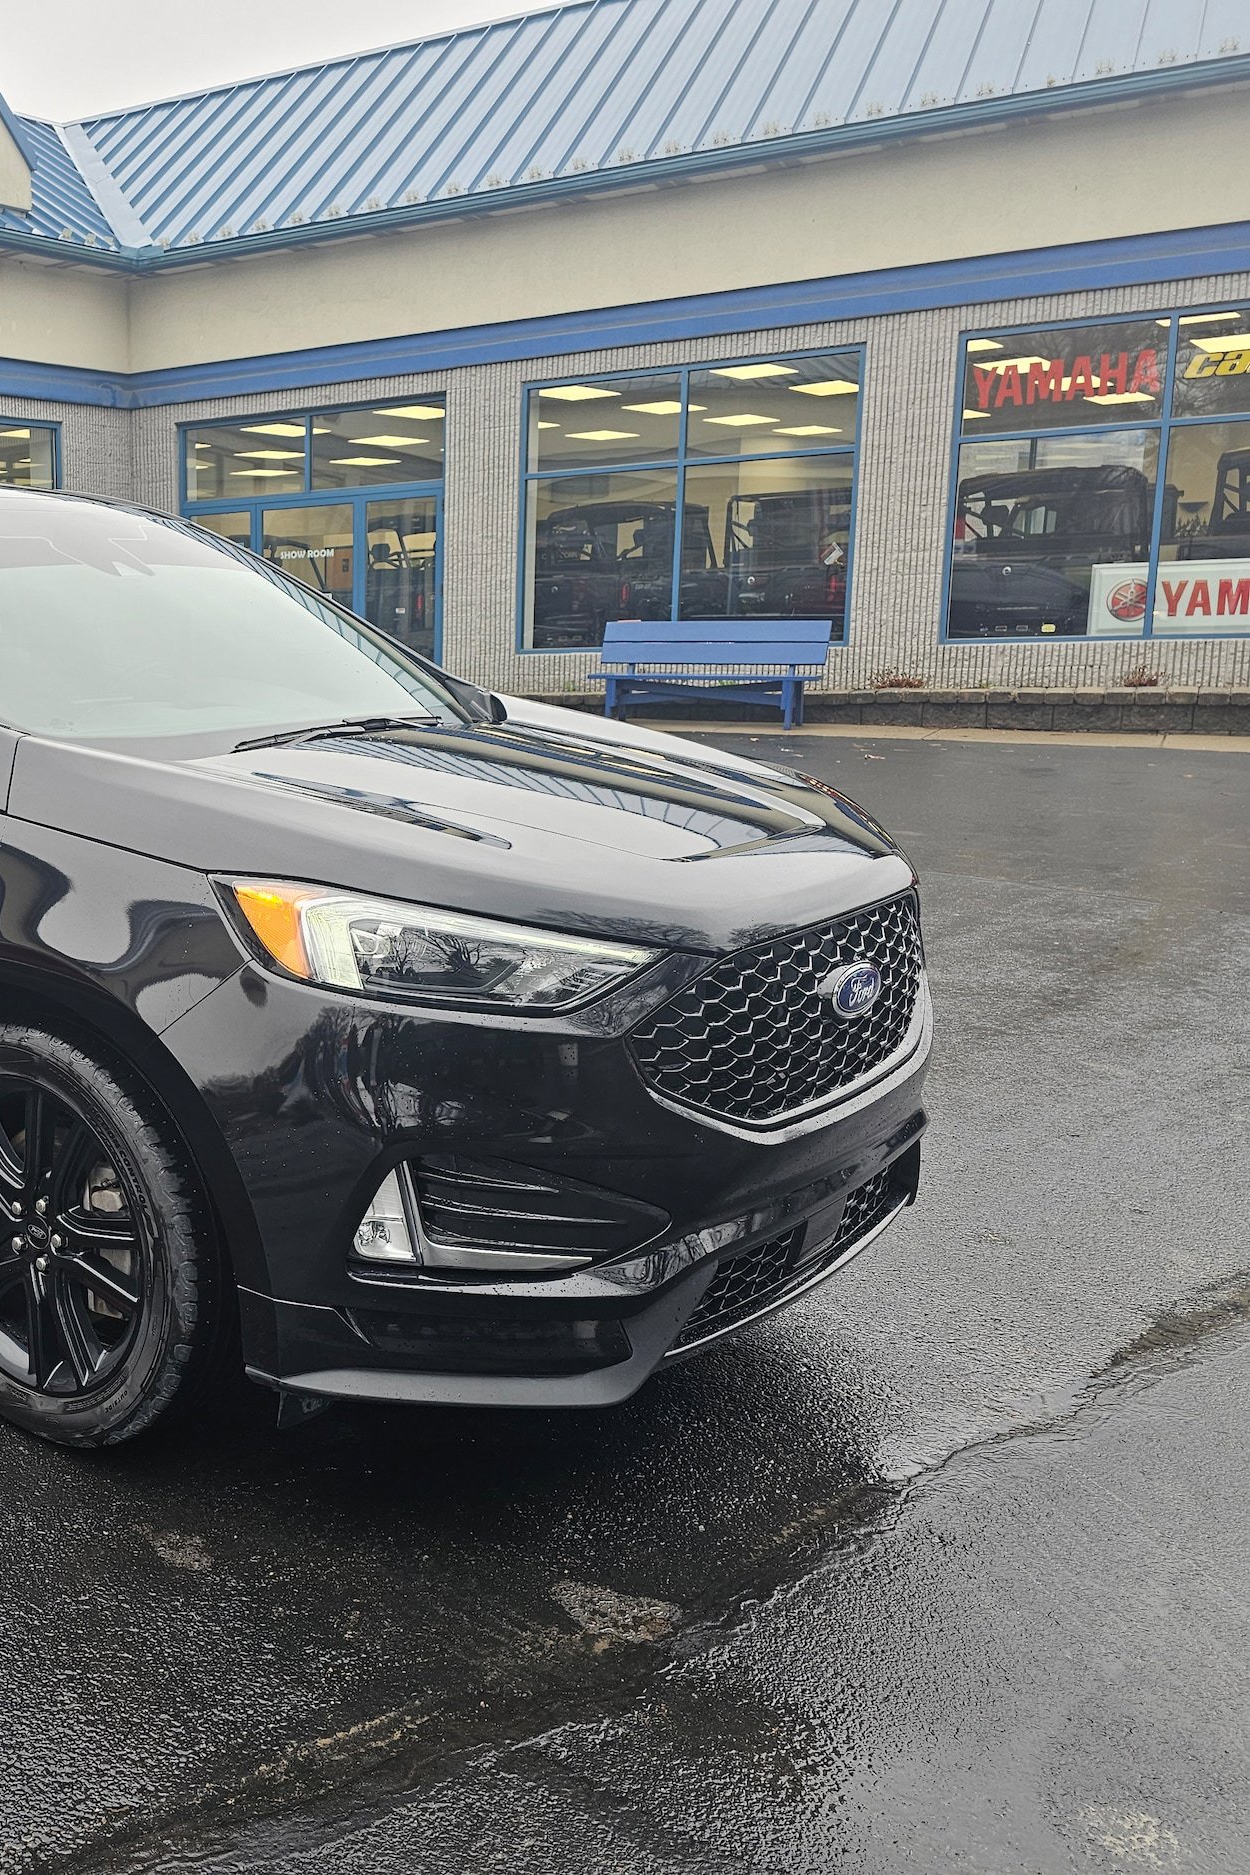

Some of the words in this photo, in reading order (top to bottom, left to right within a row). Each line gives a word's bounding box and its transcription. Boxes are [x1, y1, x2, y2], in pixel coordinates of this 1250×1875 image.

[973, 348, 1161, 409] YAMAHA
[1183, 351, 1250, 379] ca
[280, 550, 306, 559] SHOW
[307, 549, 335, 558] ROOM
[1161, 578, 1250, 617] YAM
[848, 975, 875, 1007] Ford
